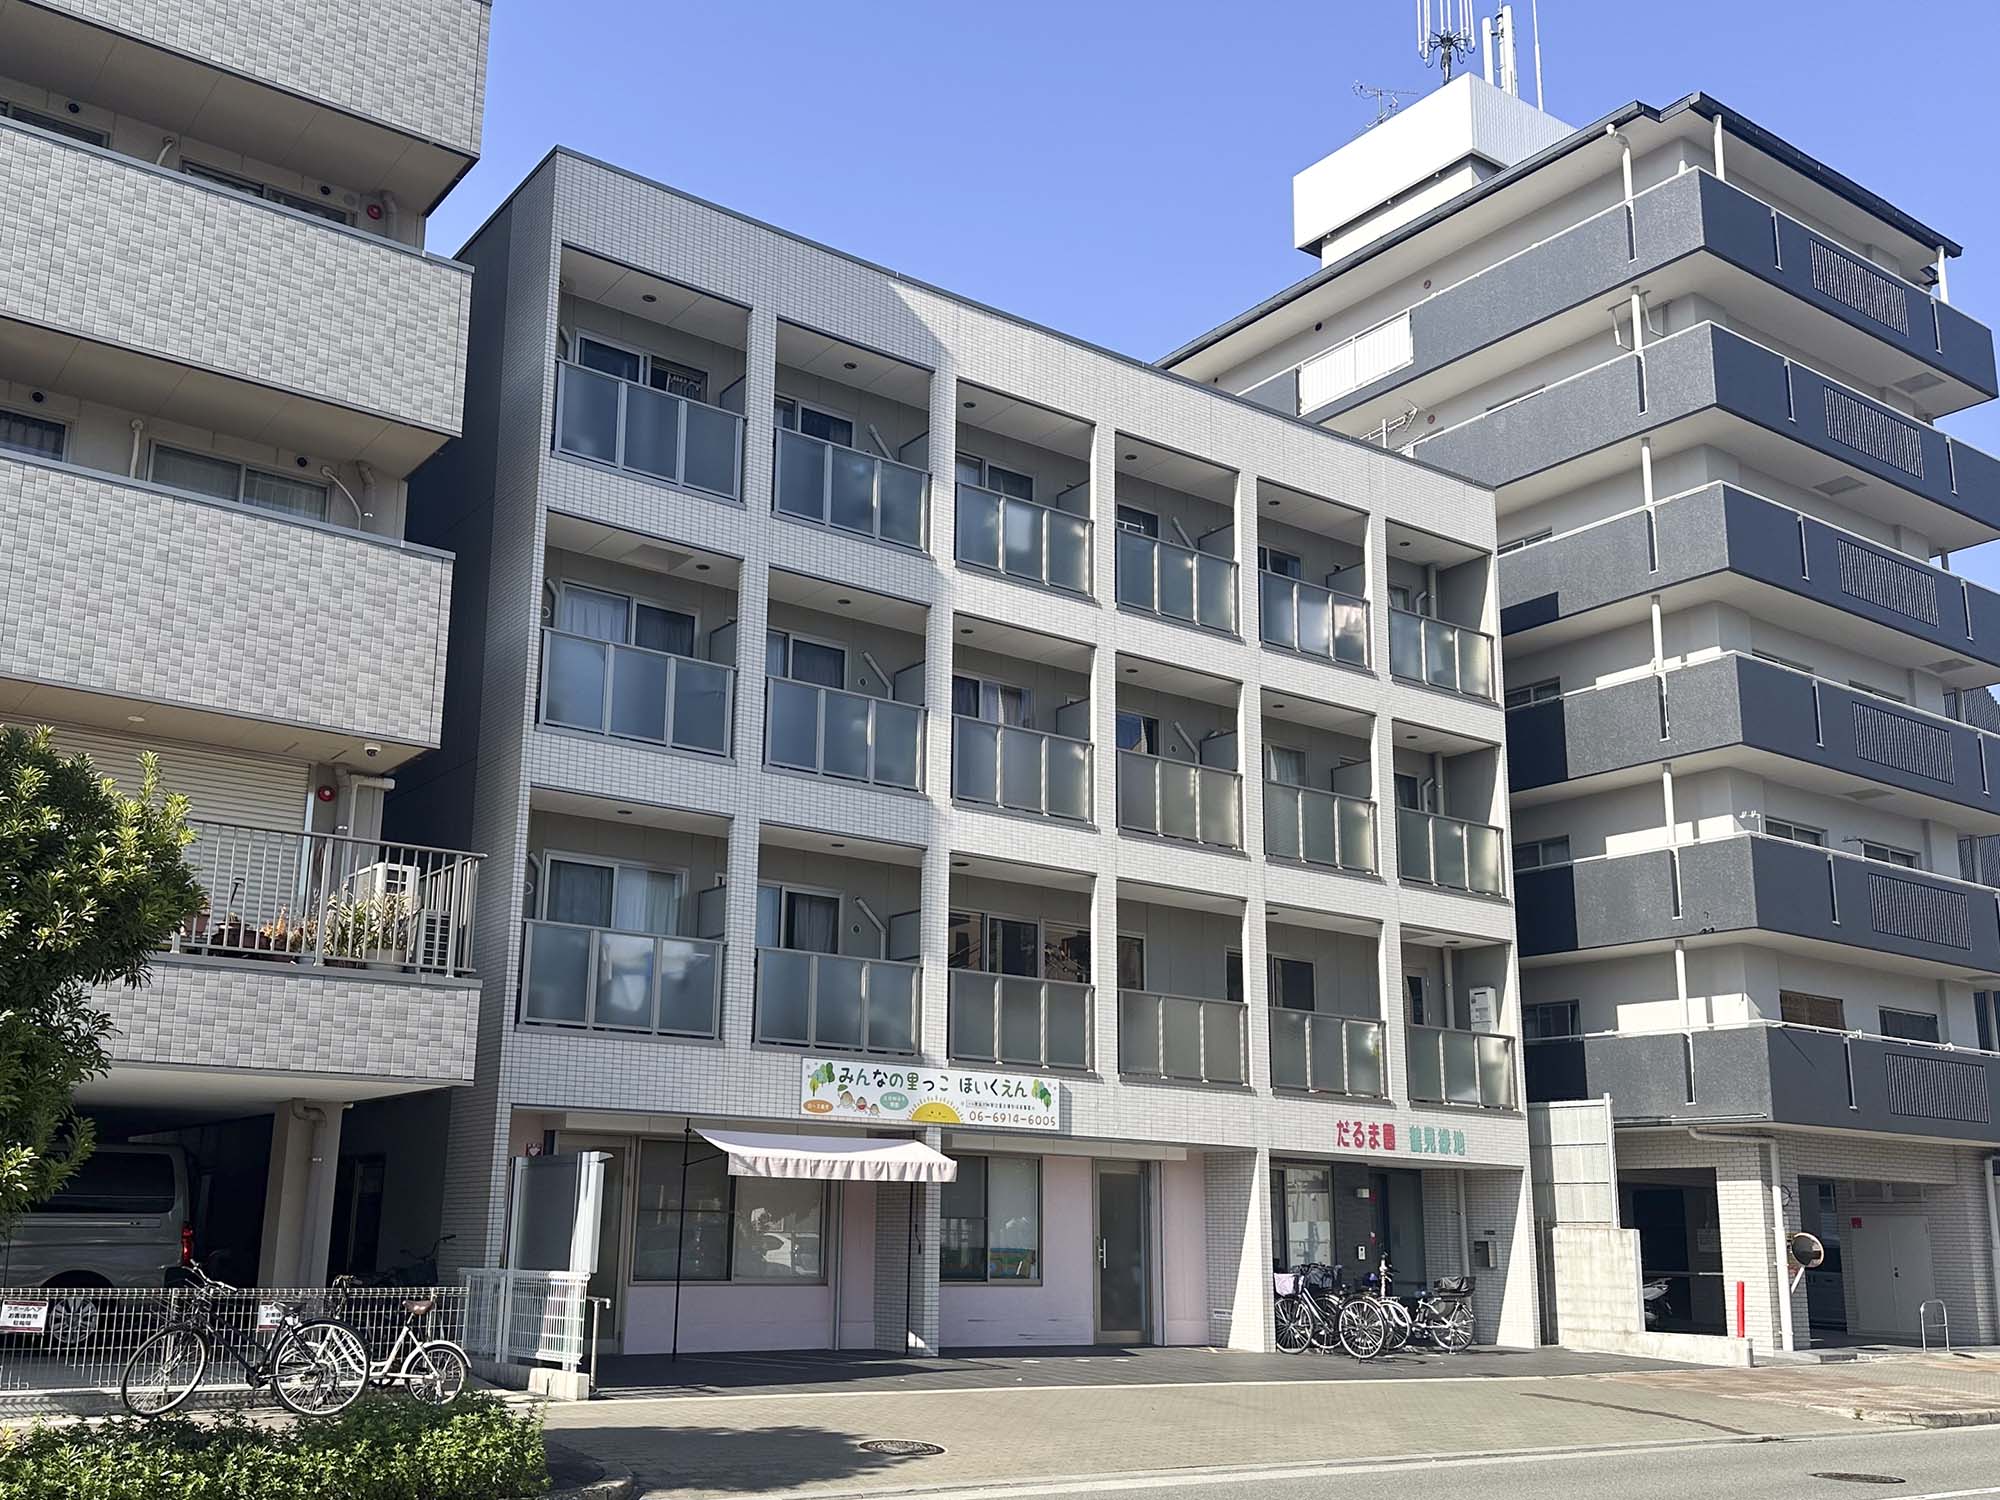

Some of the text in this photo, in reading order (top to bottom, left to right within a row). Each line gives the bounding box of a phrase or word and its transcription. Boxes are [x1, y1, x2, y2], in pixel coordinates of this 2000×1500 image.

[838, 1067, 1028, 1098] みんなの里っこ ほいくえん
[969, 1110, 1056, 1126] 06-6914-6005
